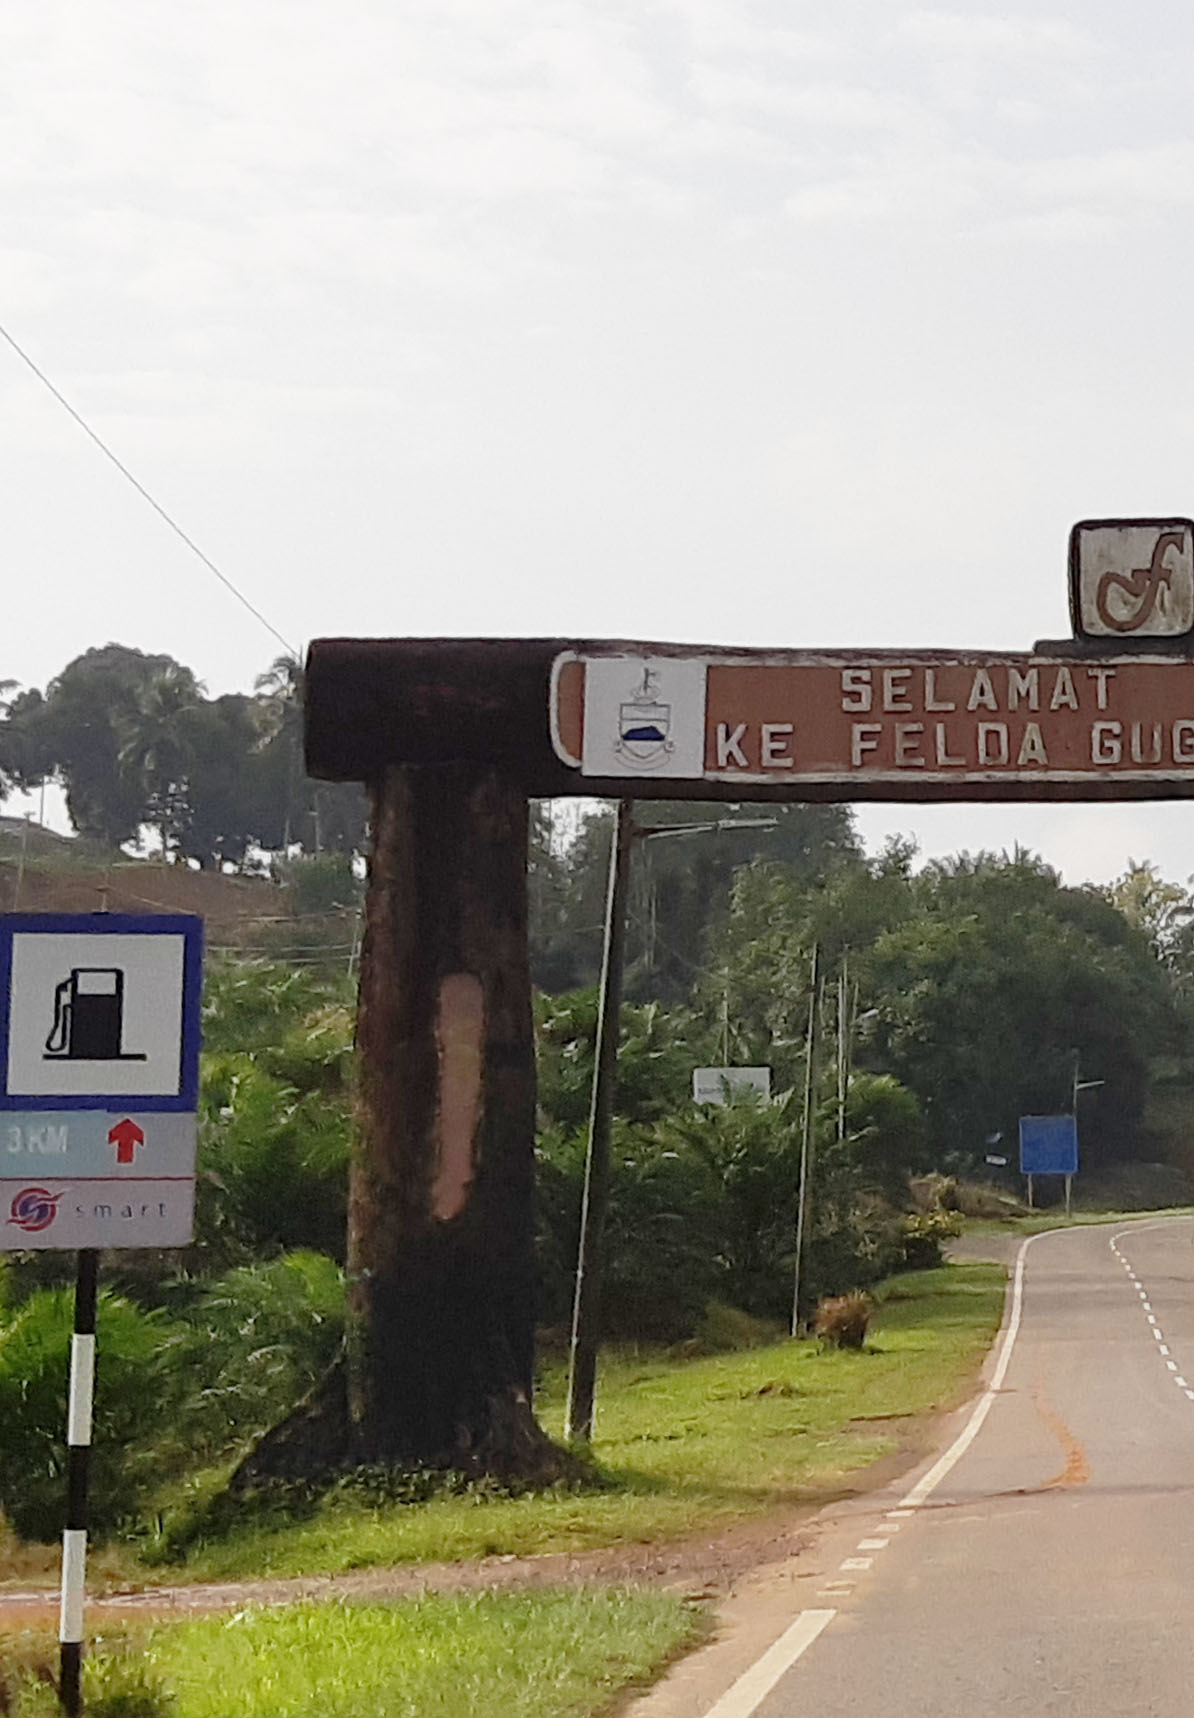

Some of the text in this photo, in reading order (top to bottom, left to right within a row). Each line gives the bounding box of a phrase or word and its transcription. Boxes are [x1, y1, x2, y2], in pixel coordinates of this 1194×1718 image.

[840, 666, 1116, 713] SELAMAT
[716, 722, 795, 768] KE
[850, 722, 1049, 767] FELDA
[8, 1124, 69, 1154] 3 KM
[75, 1202, 169, 1219] smart
